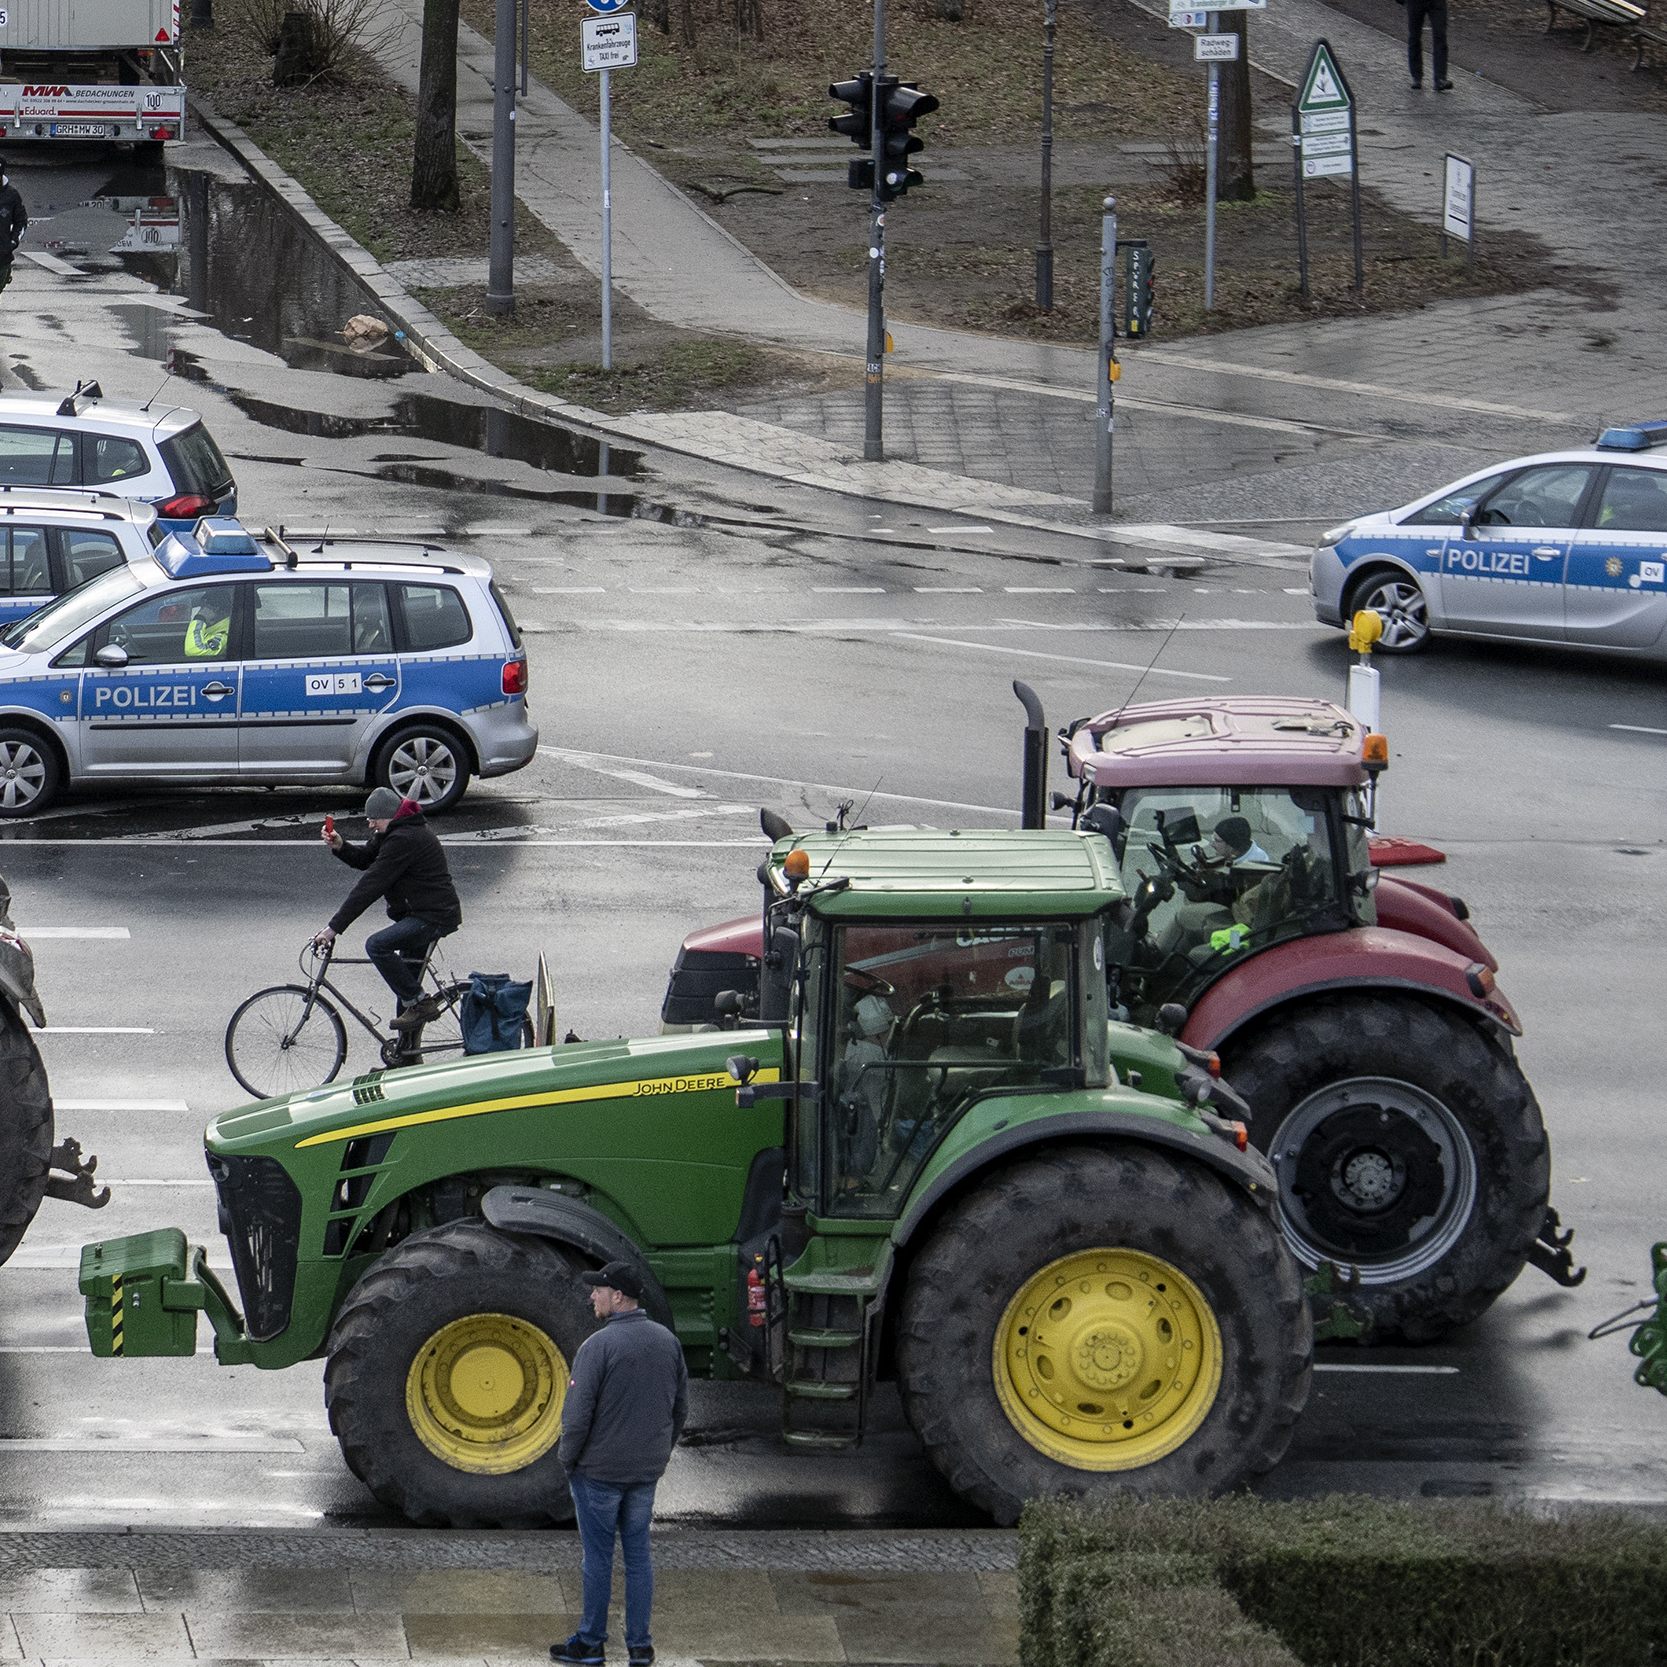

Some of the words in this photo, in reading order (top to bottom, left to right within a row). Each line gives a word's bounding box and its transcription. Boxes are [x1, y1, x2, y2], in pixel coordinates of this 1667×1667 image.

[1200, 38, 1233, 47] Radweg-
[75, 89, 135, 98] BEDACHUNGEN
[145, 93, 161, 107] 100
[56, 125, 73, 133] GRH
[93, 125, 104, 134] 30
[1447, 548, 1529, 575] POLIZEI
[1645, 566, 1659, 577] OV
[311, 679, 329, 690] OV
[95, 685, 196, 707] POLIZEI
[633, 1082, 673, 1094] JOHN
[675, 1077, 725, 1091] DEERE
